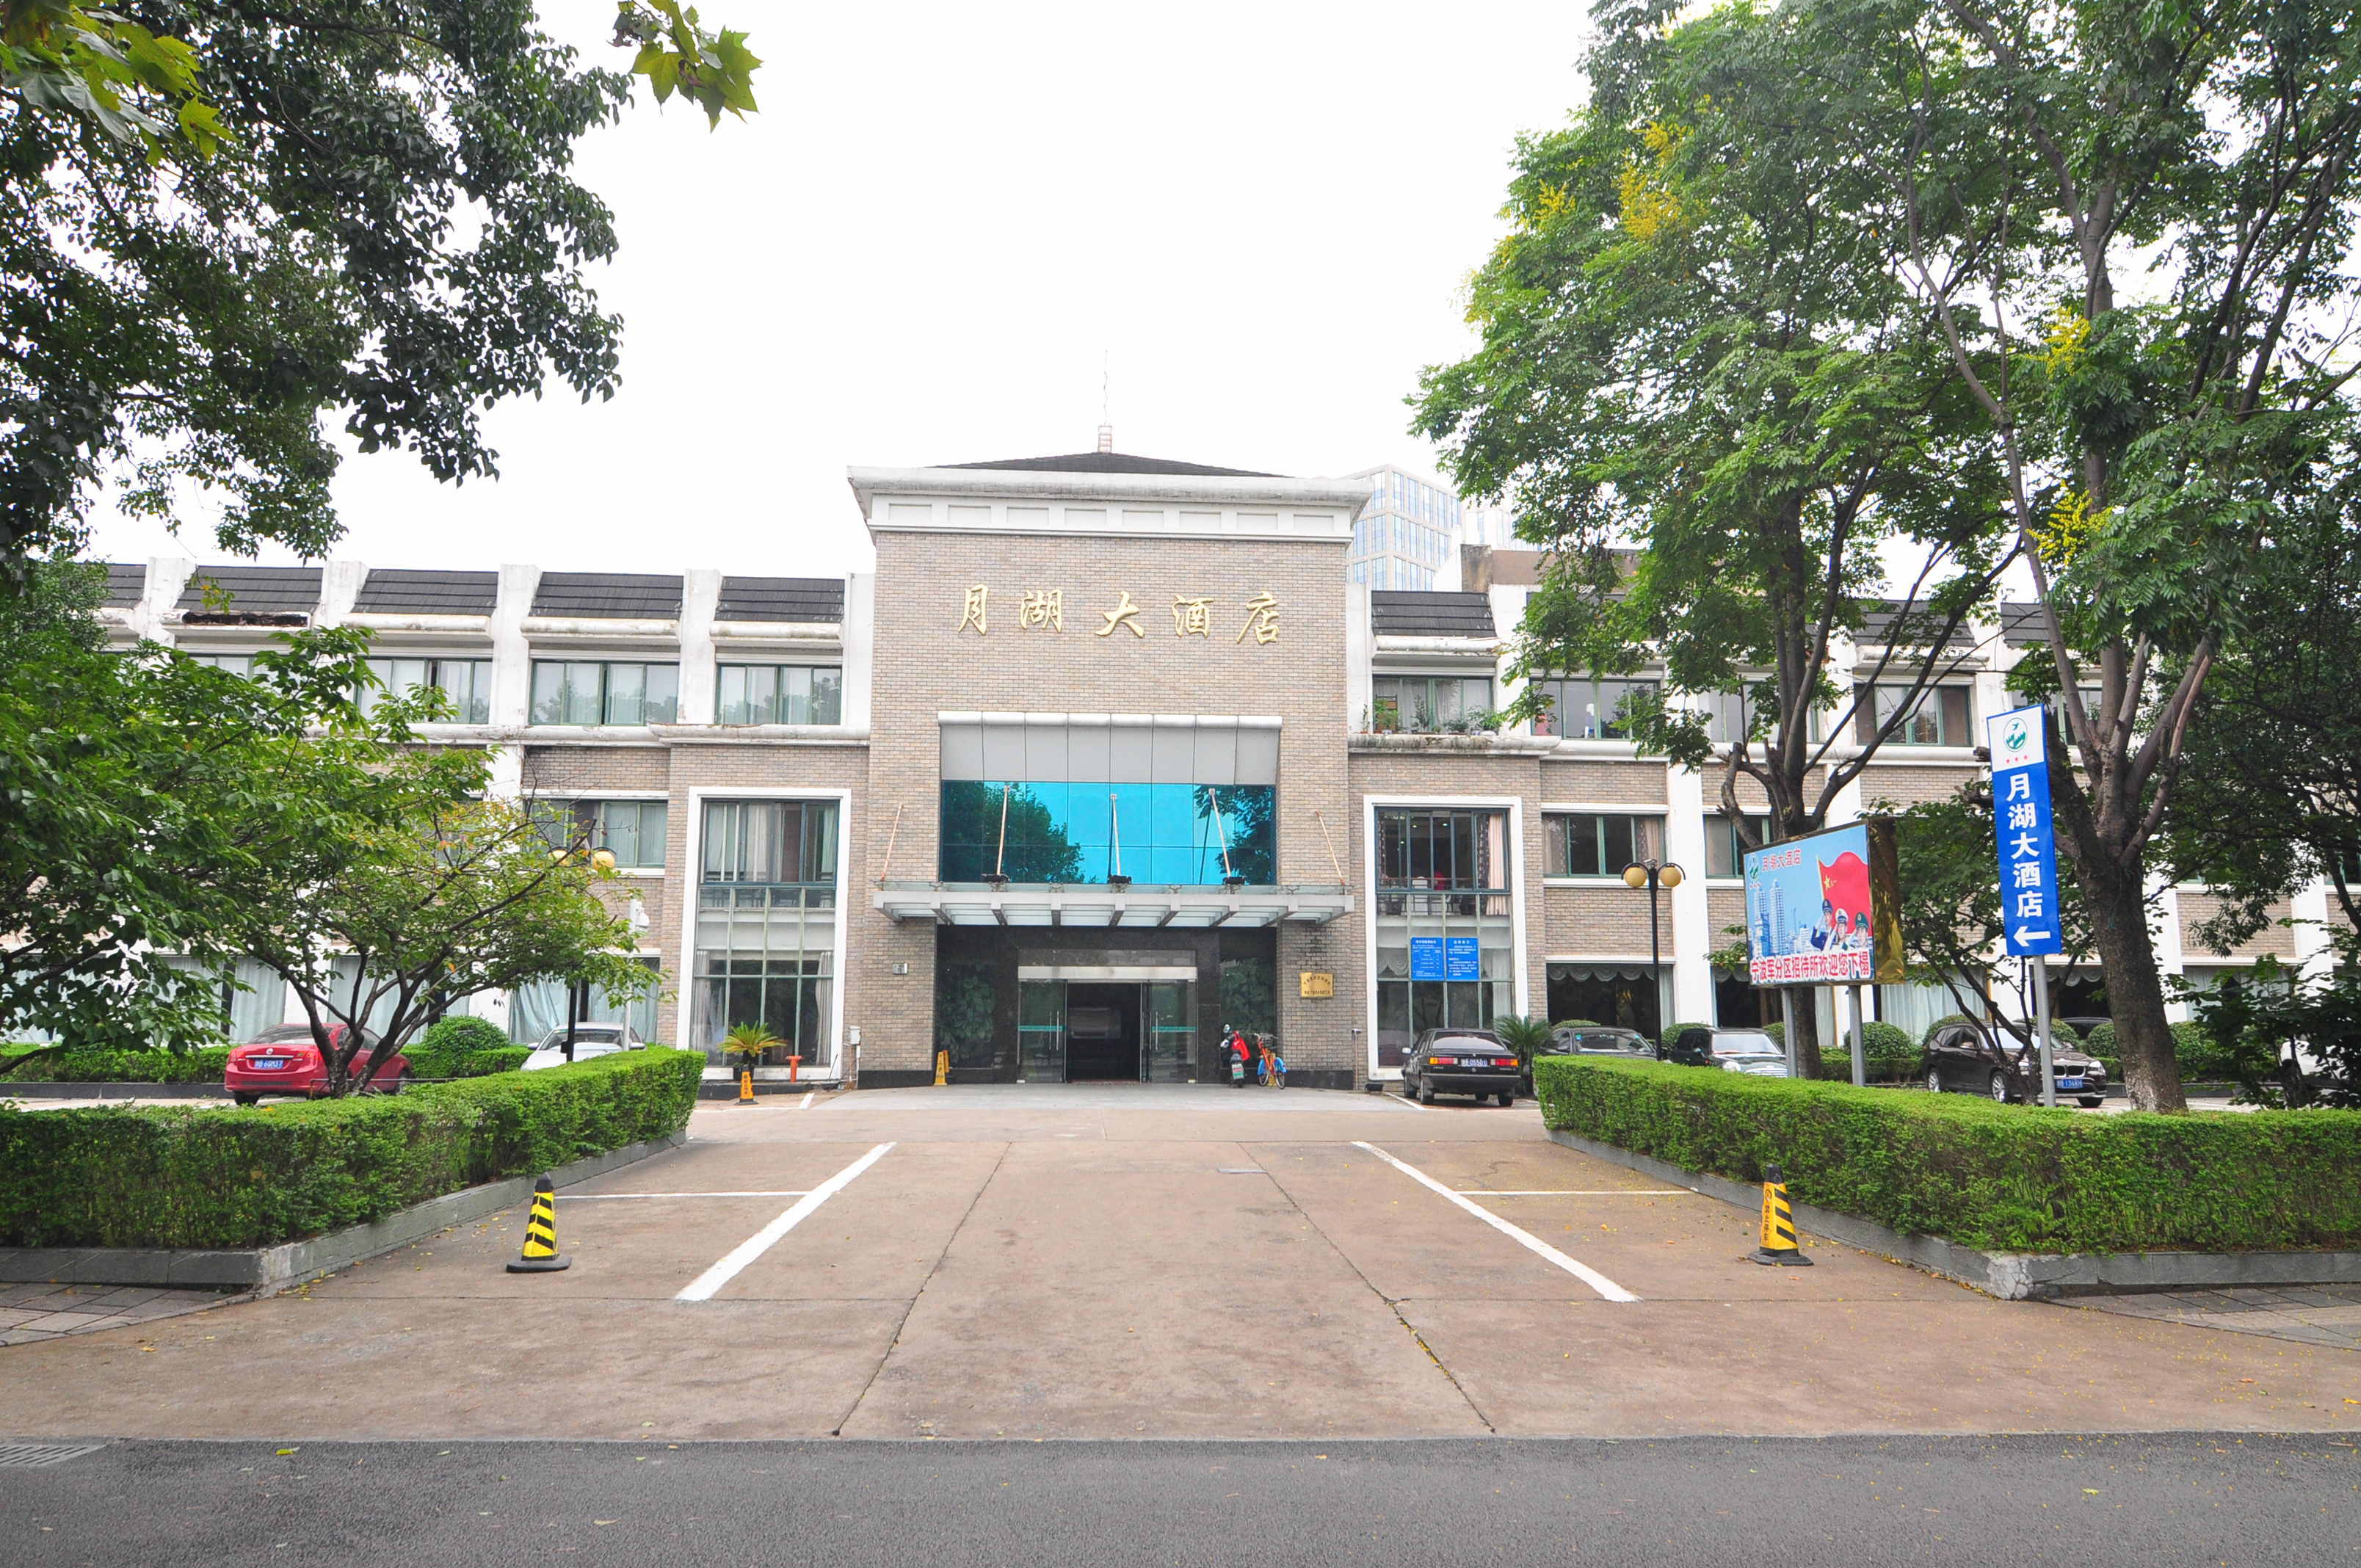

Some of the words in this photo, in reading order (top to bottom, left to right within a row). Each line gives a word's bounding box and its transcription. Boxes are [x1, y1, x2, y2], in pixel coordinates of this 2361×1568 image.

[958, 584, 1282, 645] 月湖大酒店
[2006, 772, 2044, 918] 月湖大酒店
[1750, 951, 1870, 981] 宁波军分区招待所欢迎您下榻
